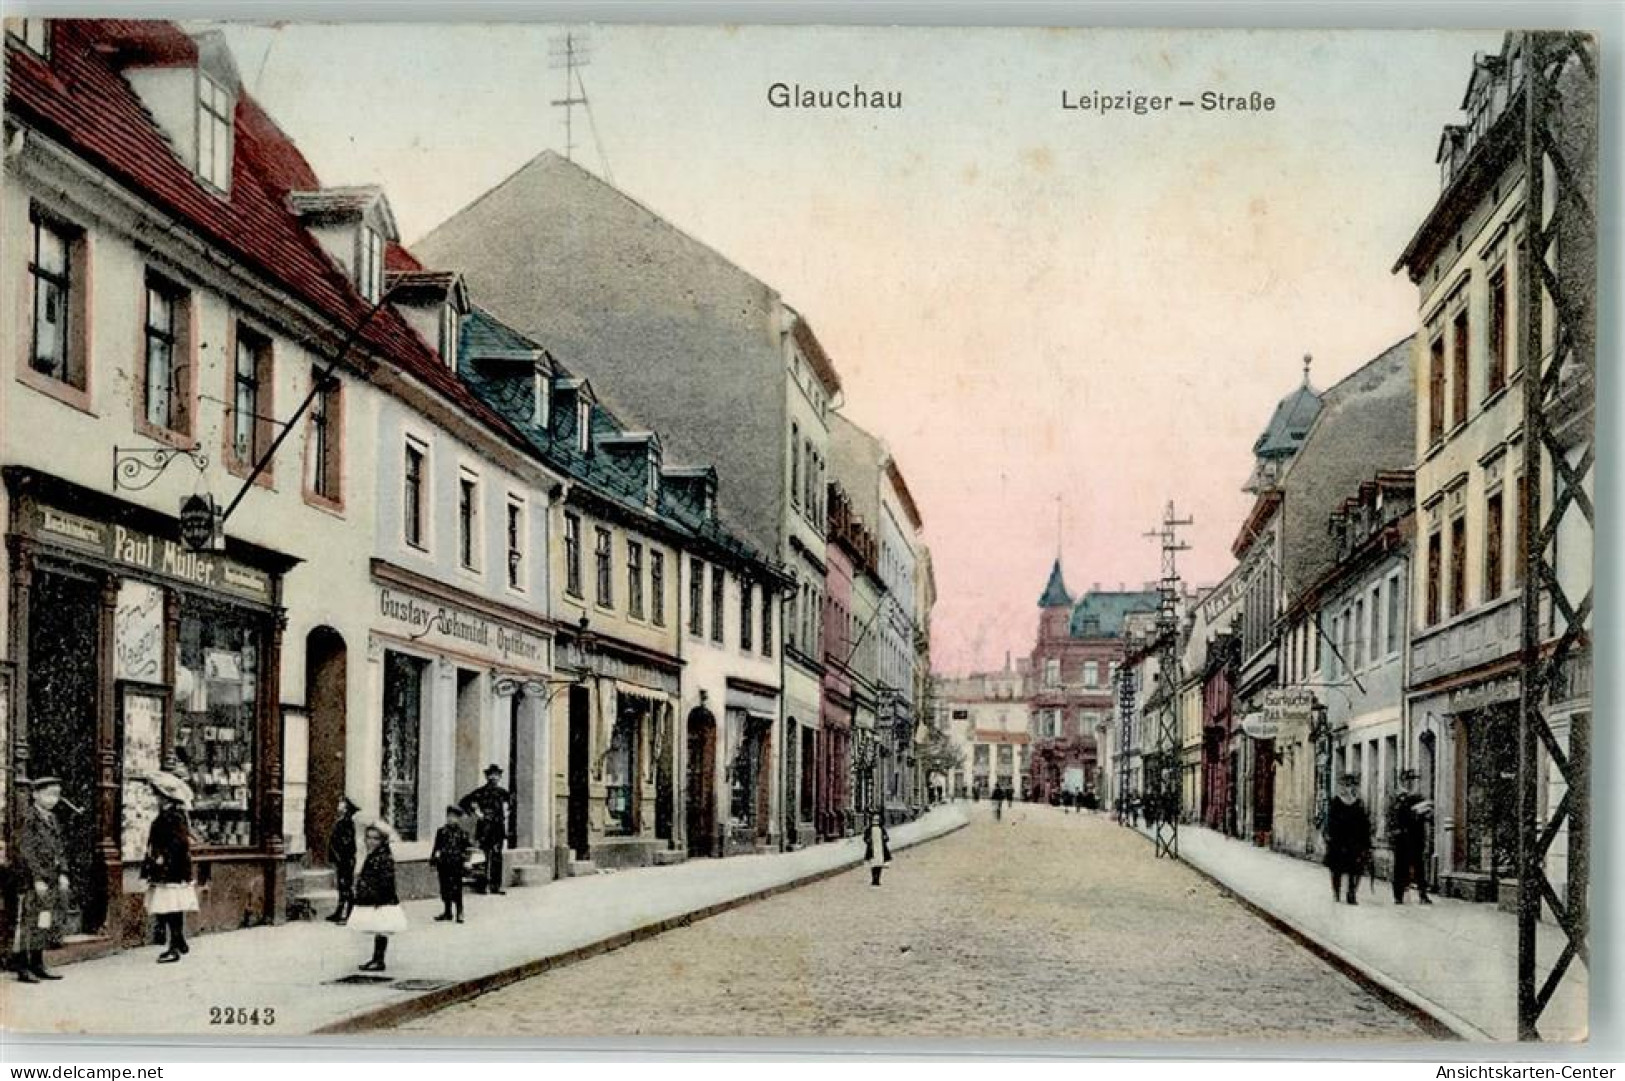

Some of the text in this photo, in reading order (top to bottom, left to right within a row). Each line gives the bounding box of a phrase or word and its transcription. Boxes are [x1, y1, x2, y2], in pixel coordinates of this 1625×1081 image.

[767, 83, 903, 109] Glauchau
[1061, 90, 1173, 115] Leipziger
[1200, 91, 1277, 112] Straße
[113, 525, 154, 567] Paul
[380, 589, 430, 627] Gustav
[437, 607, 488, 646] Schmidt
[209, 1006, 276, 1025] 22543
